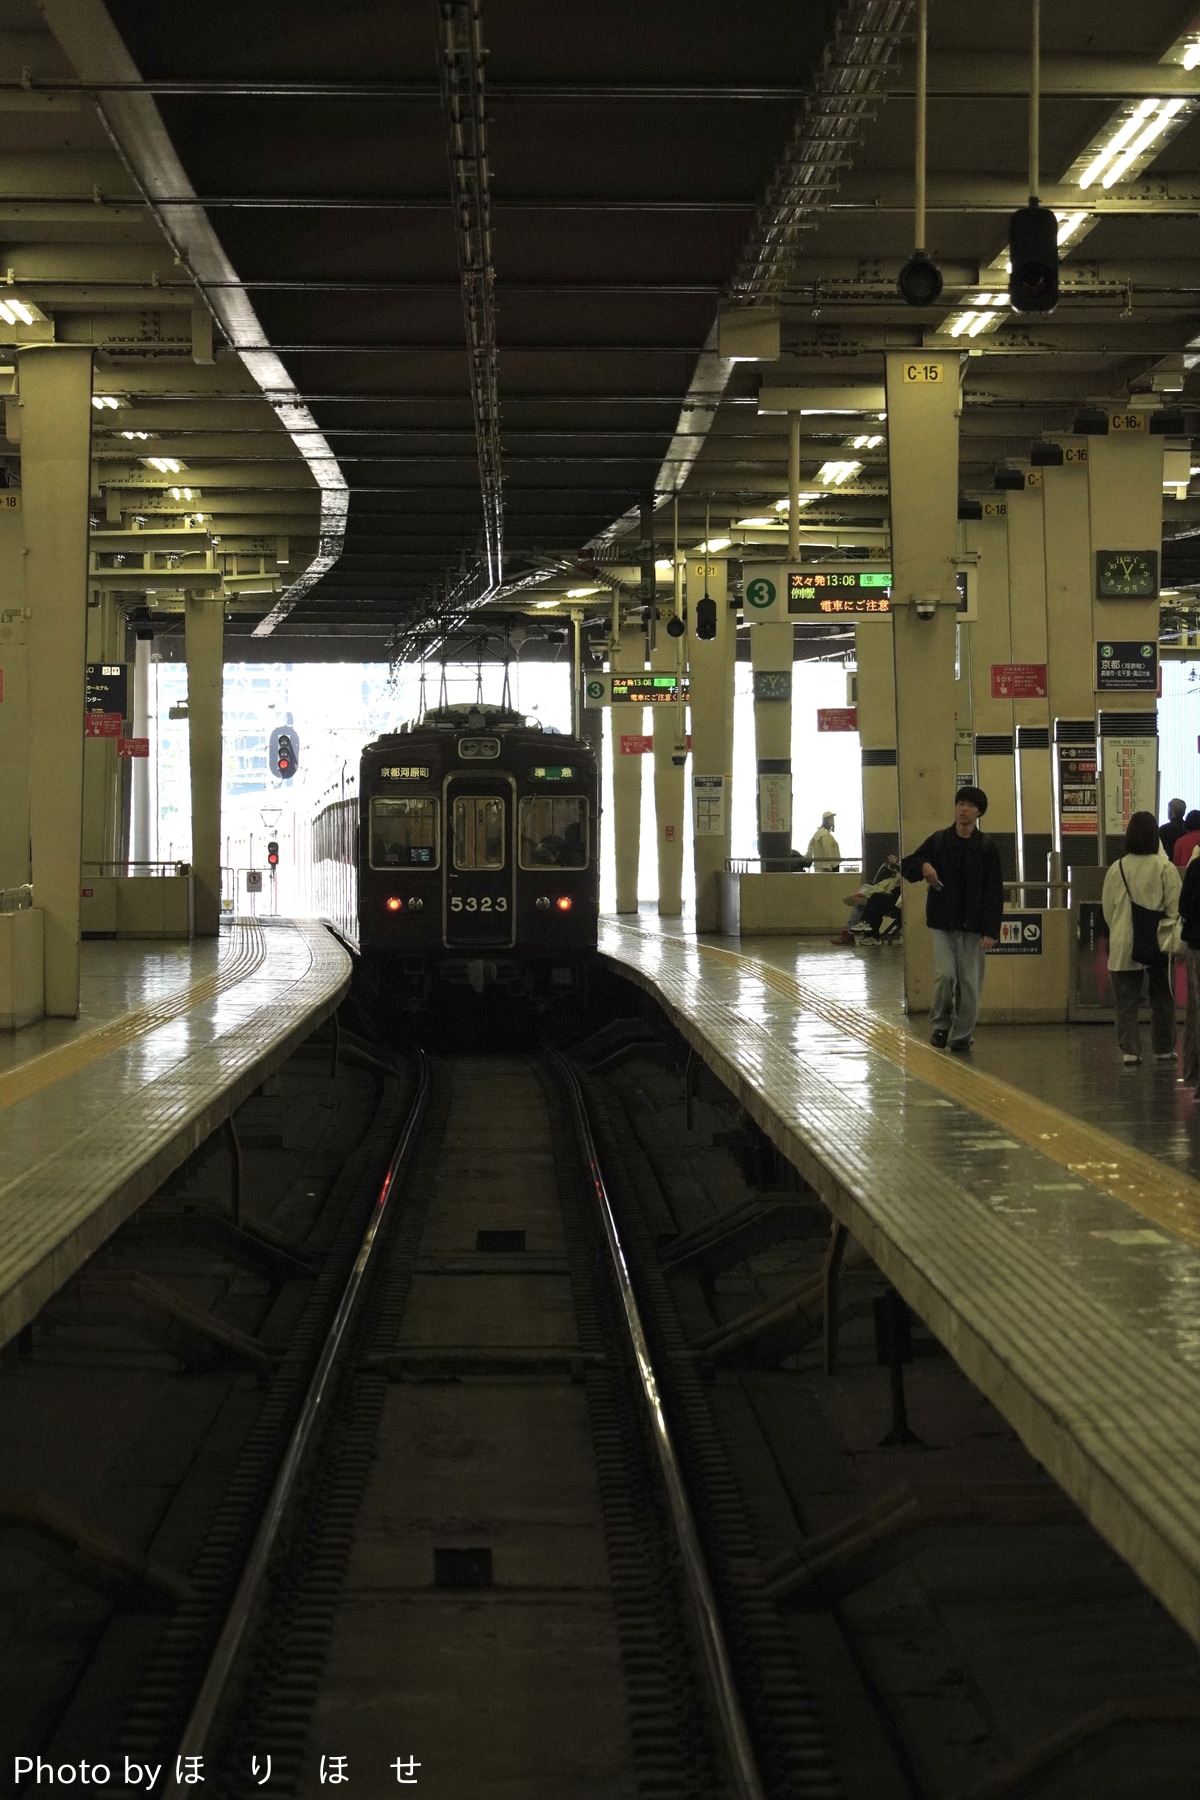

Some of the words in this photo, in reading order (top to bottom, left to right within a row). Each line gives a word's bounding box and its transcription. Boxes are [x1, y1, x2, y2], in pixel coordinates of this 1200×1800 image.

[907, 365, 939, 380] C-15
[1065, 449, 1087, 461] C-16
[1028, 473, 1042, 486] C-
[0, 496, 17, 507] -18
[985, 504, 1007, 515] C-18
[792, 575, 826, 586] 次々発
[826, 575, 855, 586] 13:06
[753, 582, 770, 605] 3
[1103, 646, 1111, 657] 3
[1143, 646, 1151, 657] 2
[591, 683, 601, 697] 3
[380, 767, 429, 777] 京都河原町
[534, 767, 573, 778] 準急
[451, 896, 508, 912] 5323
